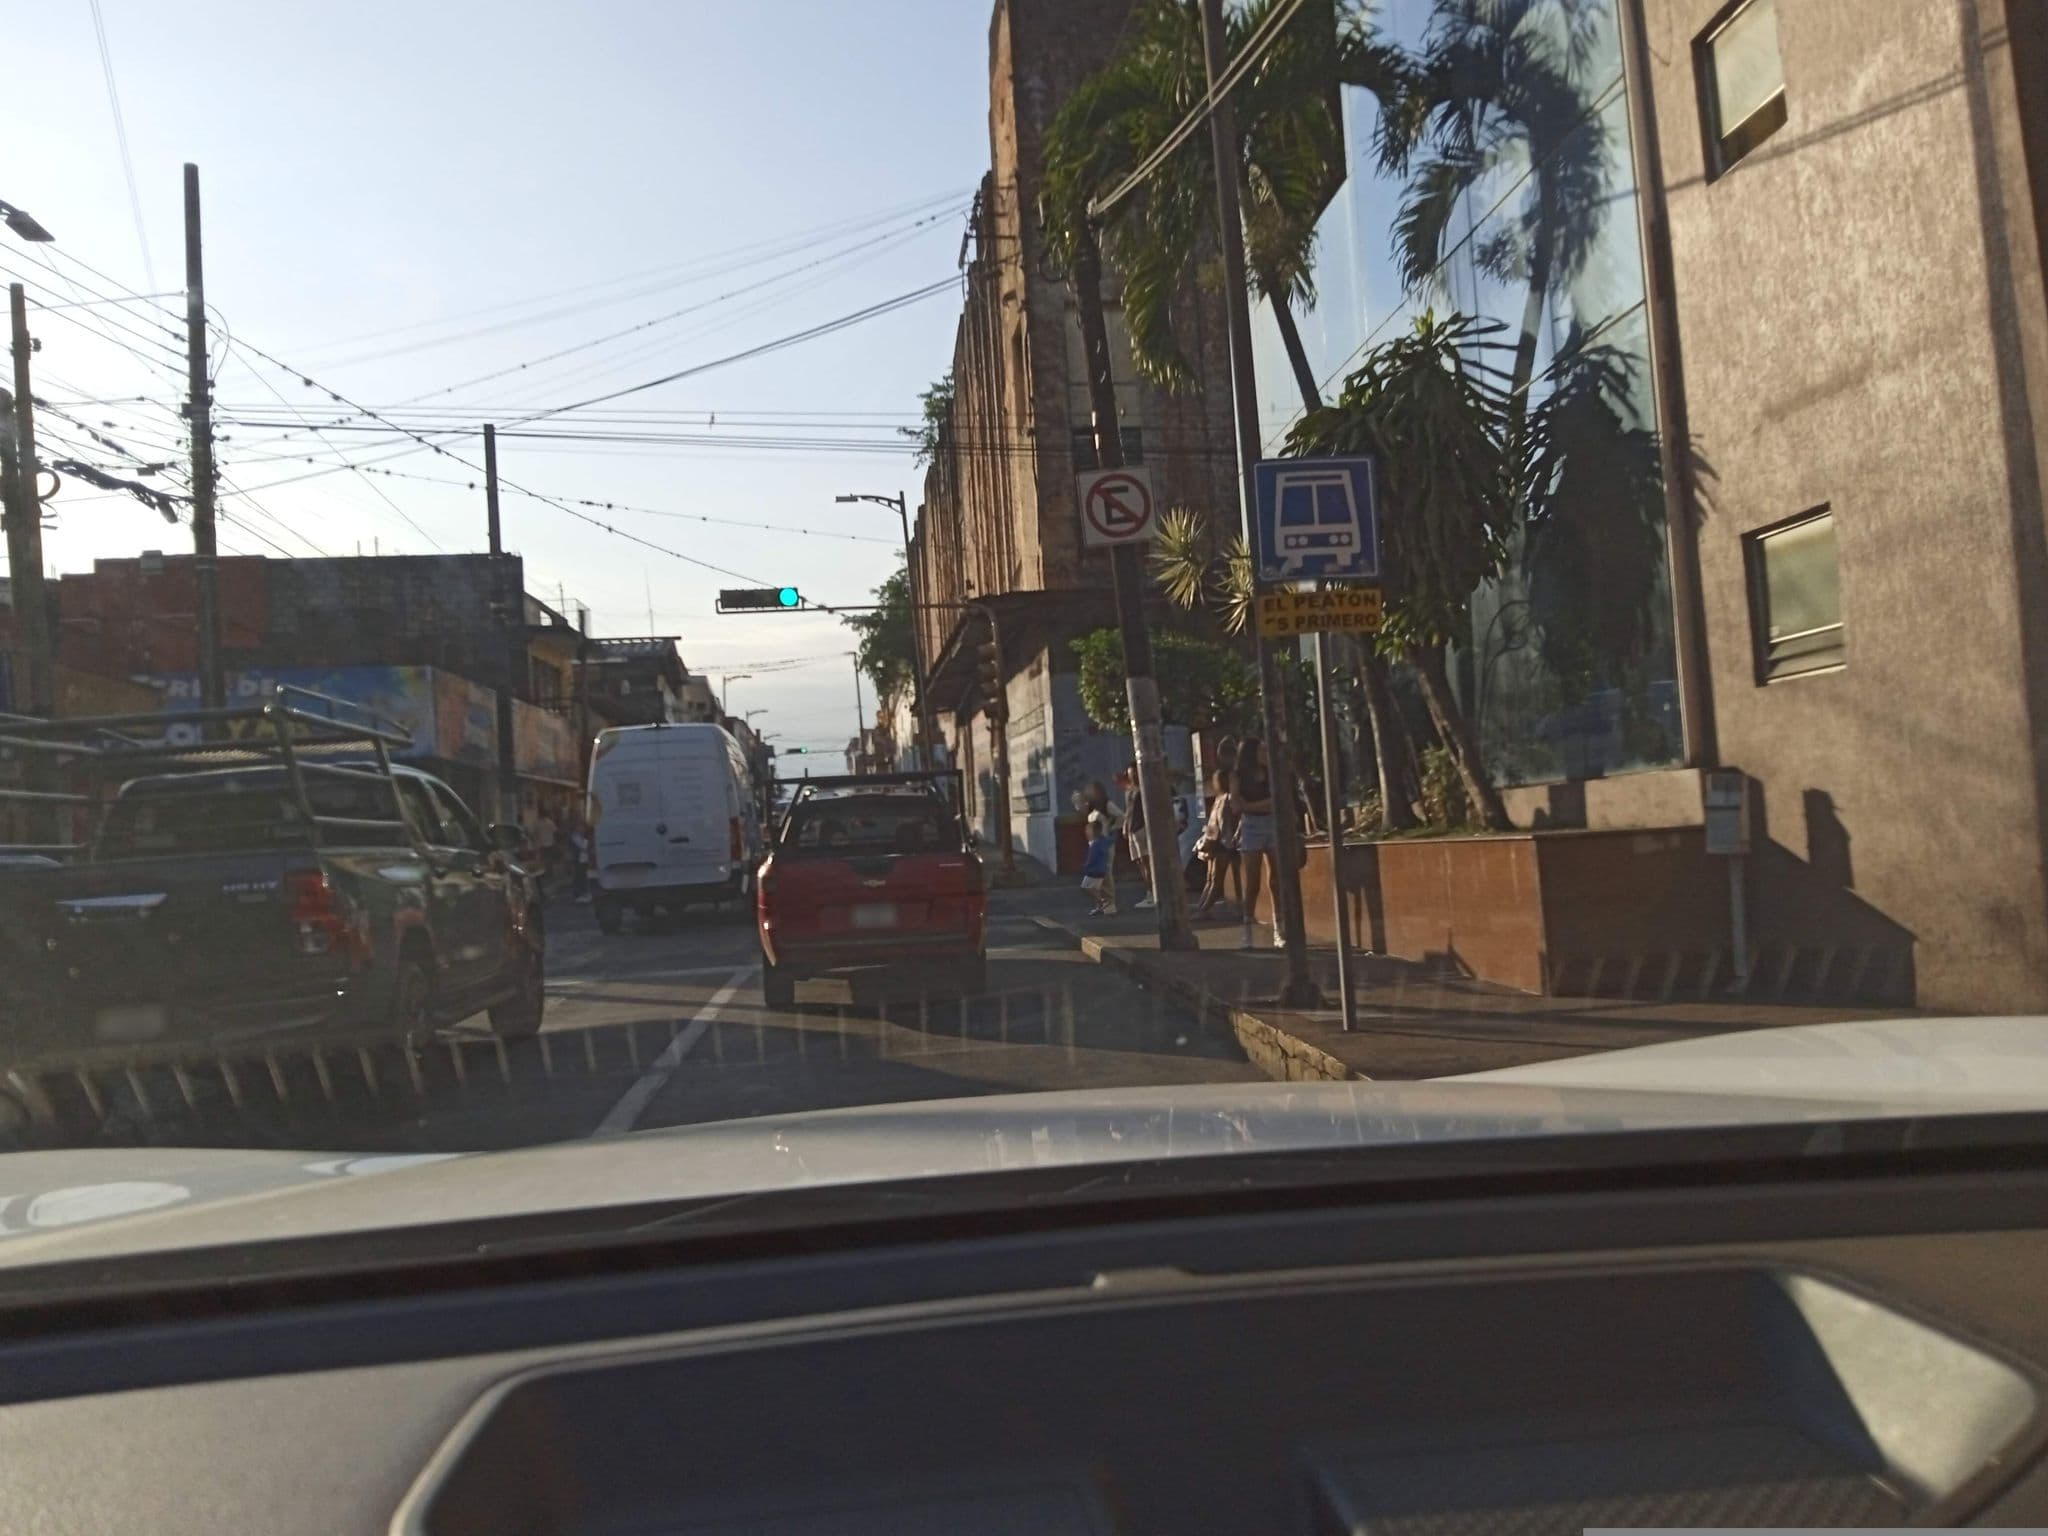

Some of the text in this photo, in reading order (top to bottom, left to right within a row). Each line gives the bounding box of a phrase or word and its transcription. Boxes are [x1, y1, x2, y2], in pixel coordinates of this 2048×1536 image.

[1101, 485, 1137, 526] E
[1263, 592, 1378, 613] EL PEATON
[1295, 613, 1378, 630] PRIMERO
